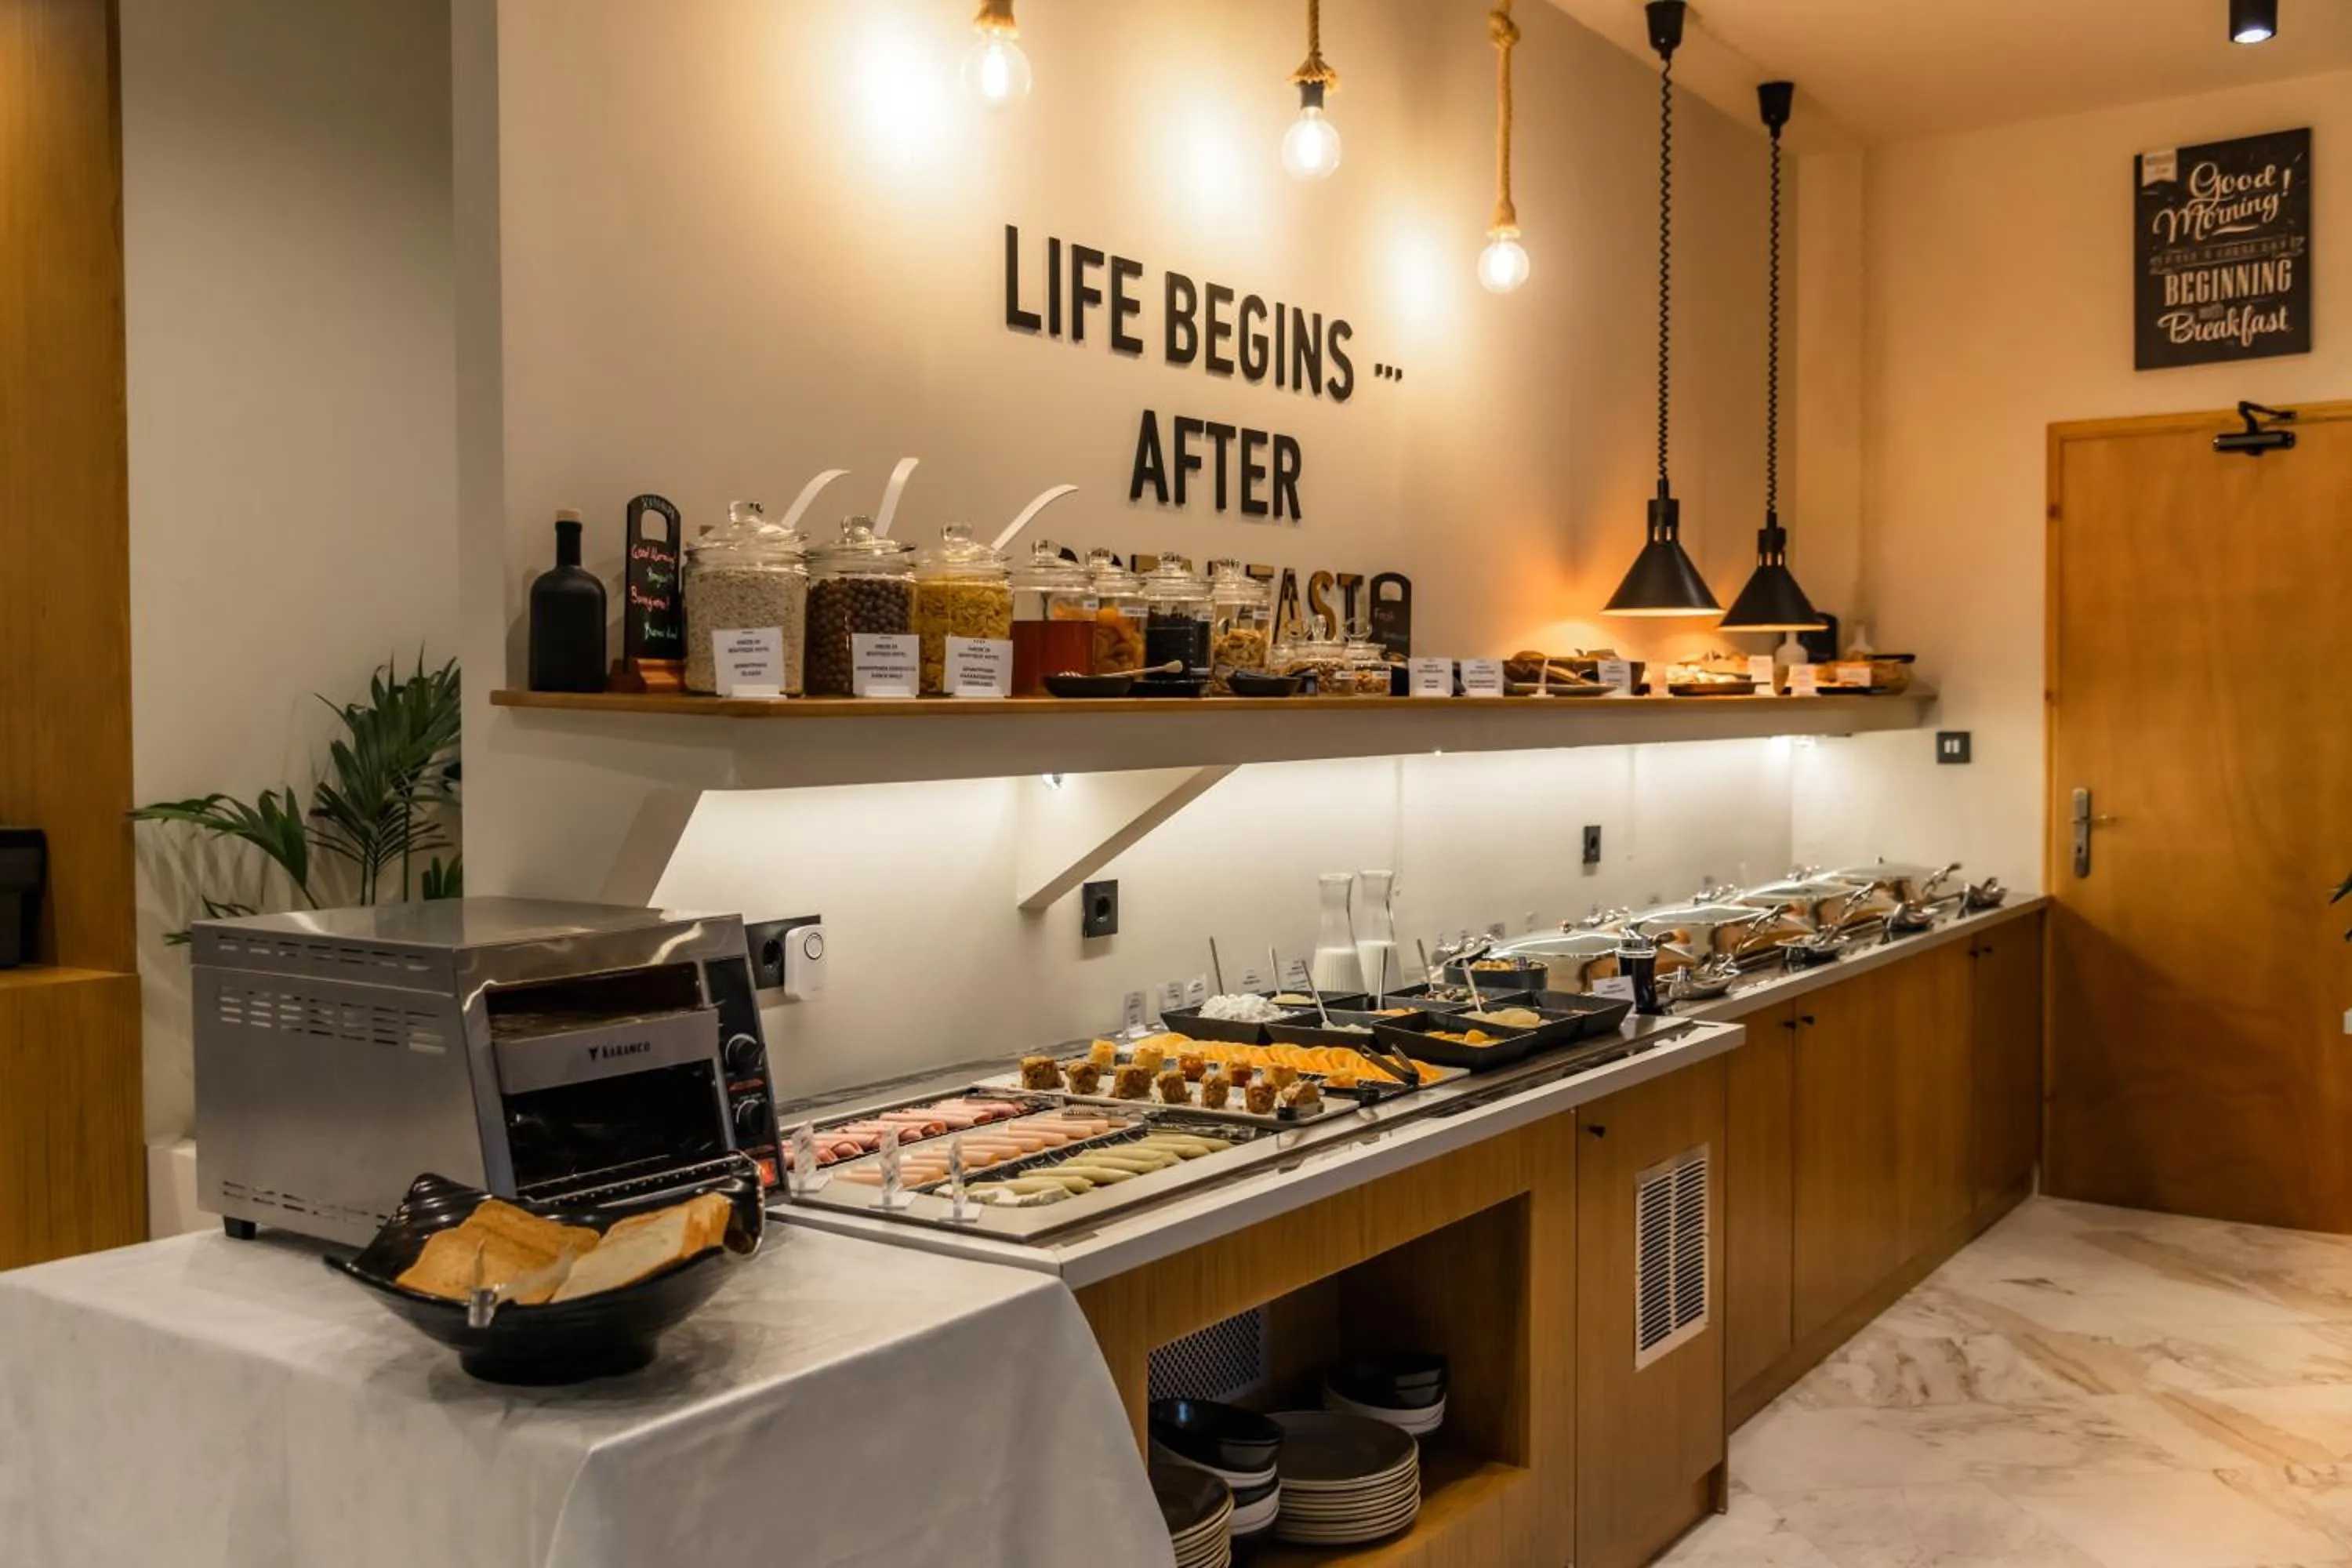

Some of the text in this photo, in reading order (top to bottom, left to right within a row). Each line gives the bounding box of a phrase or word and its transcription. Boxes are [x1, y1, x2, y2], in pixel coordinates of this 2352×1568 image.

[2153, 193, 2278, 243] Morning
[2164, 260, 2292, 307] BEGINNING
[1005, 224, 1144, 354] LIFE
[1165, 270, 1355, 401] BEGINS
[2158, 305, 2288, 347] Breakfast
[1130, 409, 1301, 520] AFTER
